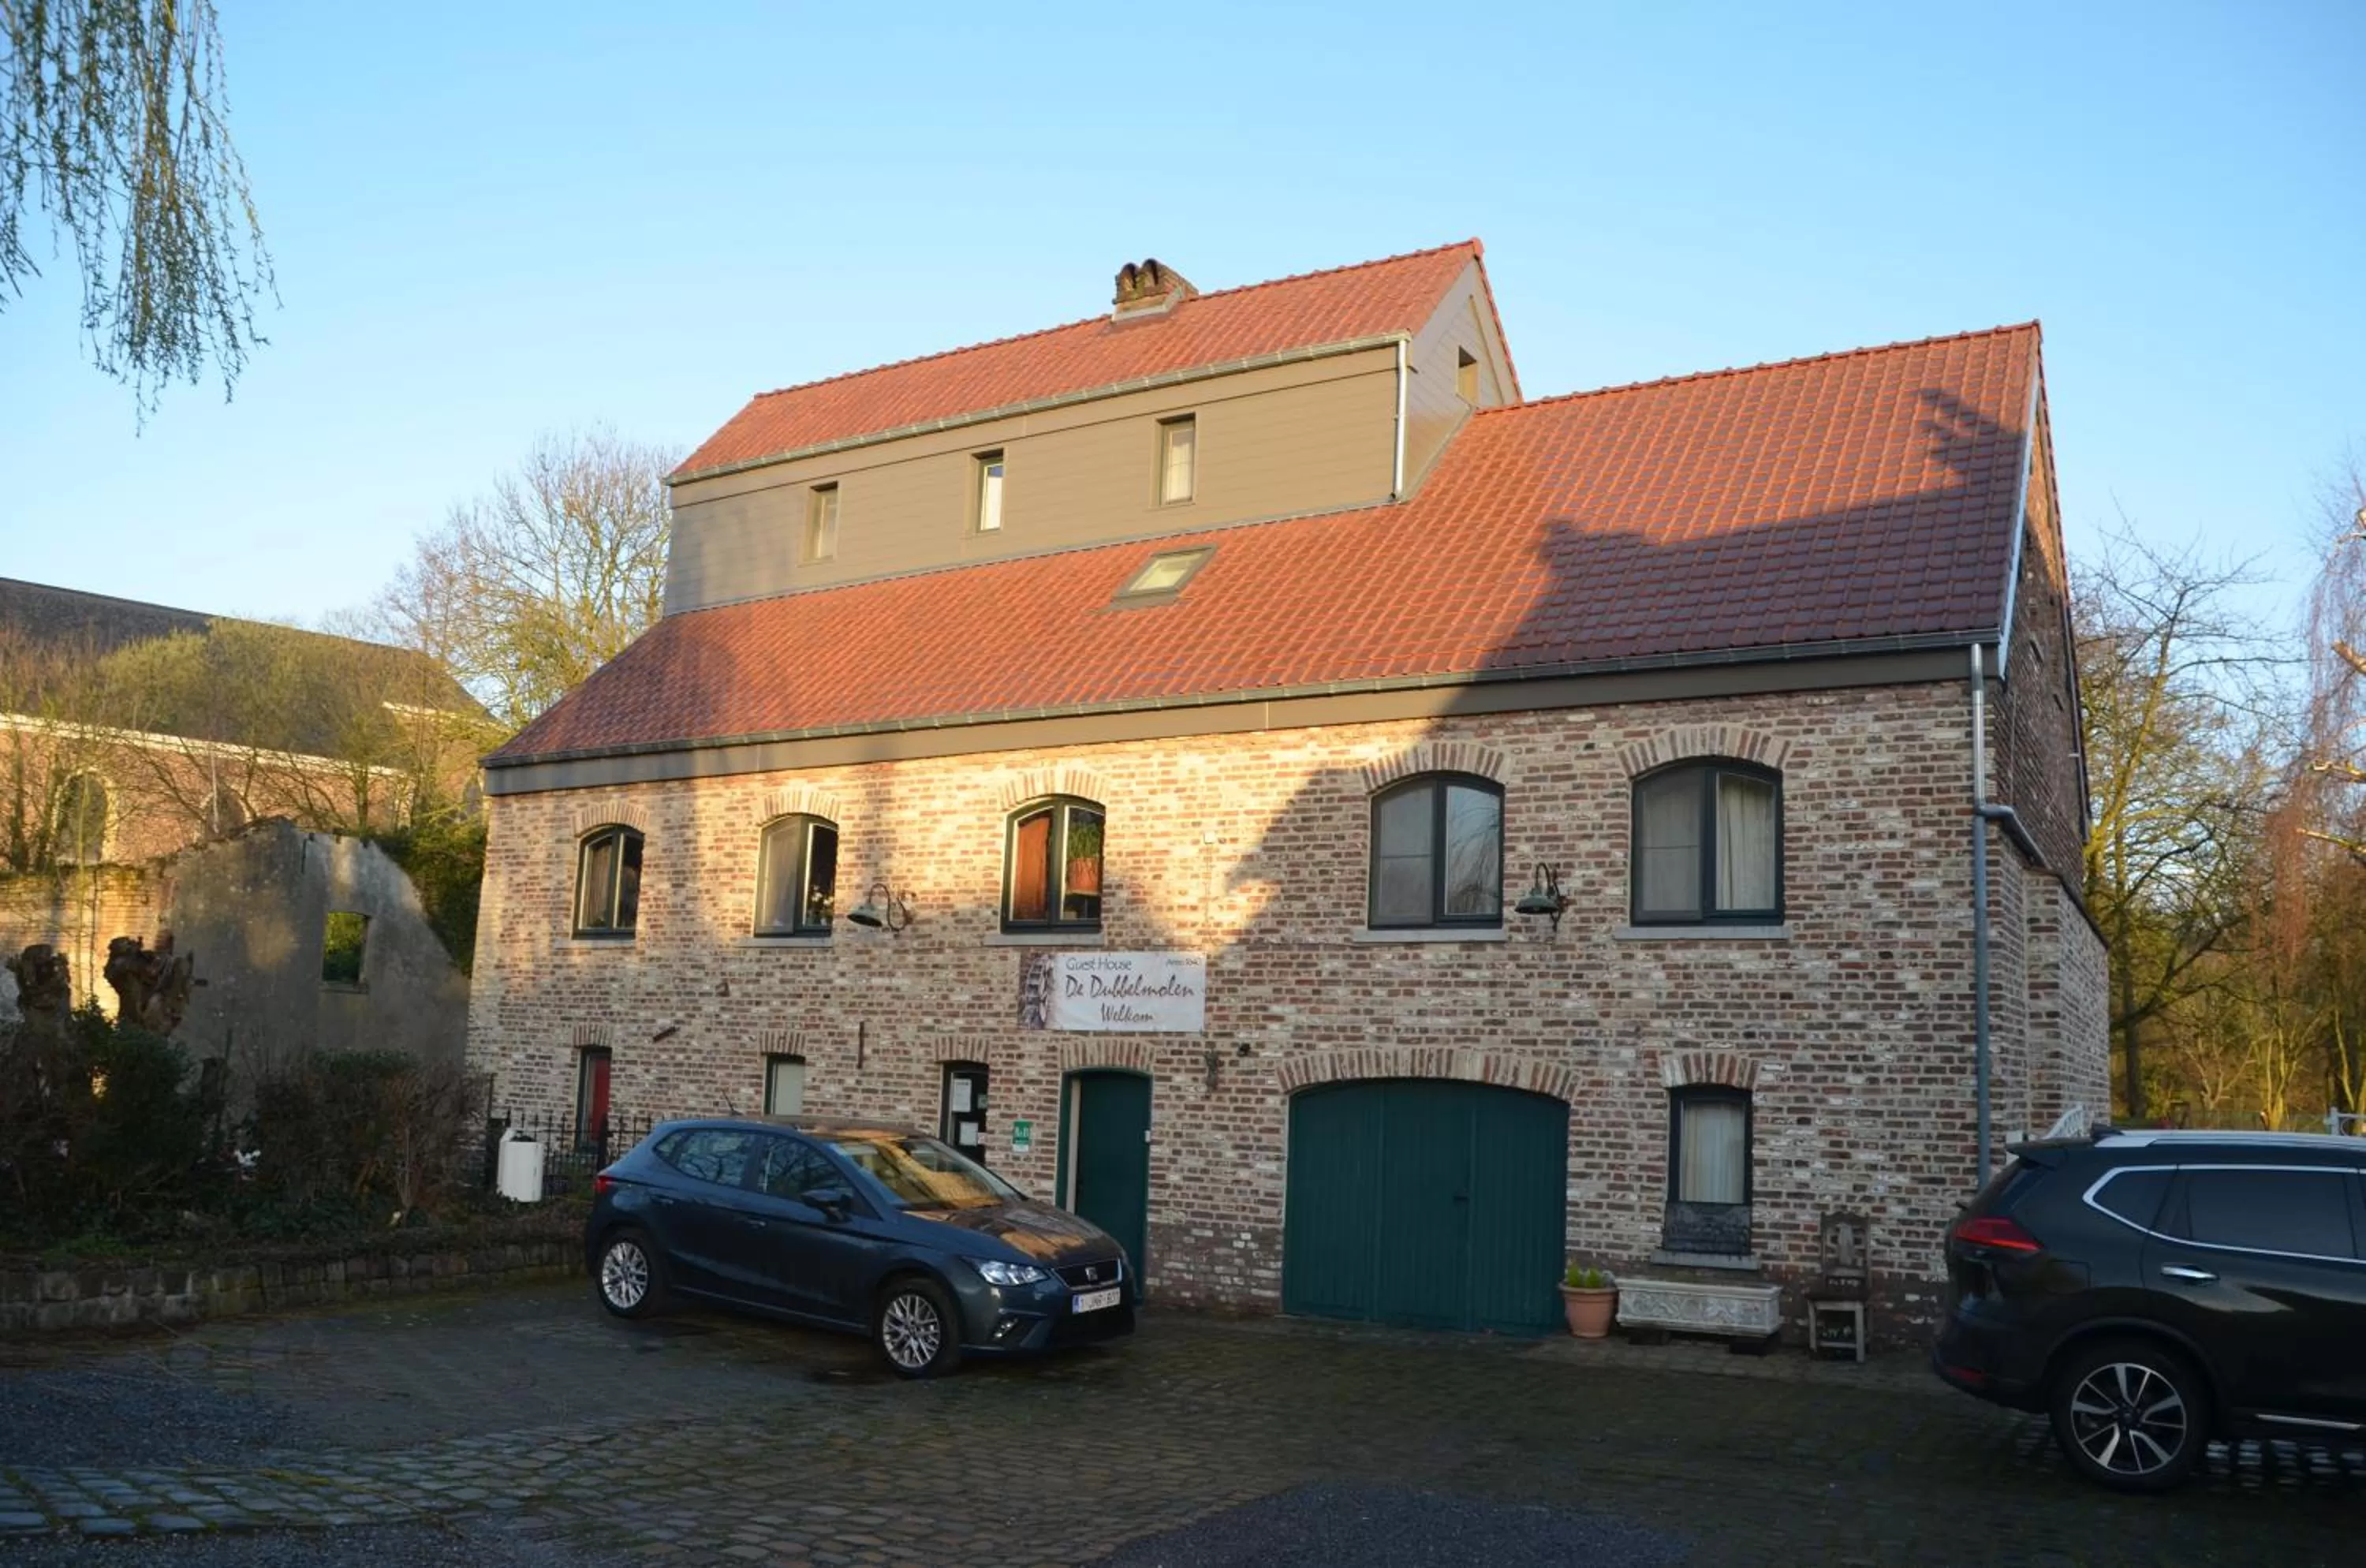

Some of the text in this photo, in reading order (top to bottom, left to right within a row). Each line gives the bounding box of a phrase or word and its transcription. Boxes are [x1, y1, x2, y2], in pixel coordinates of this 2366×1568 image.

[1065, 974, 1195, 998] De Dubbelmolen
[1101, 1002, 1154, 1022] Welkom
